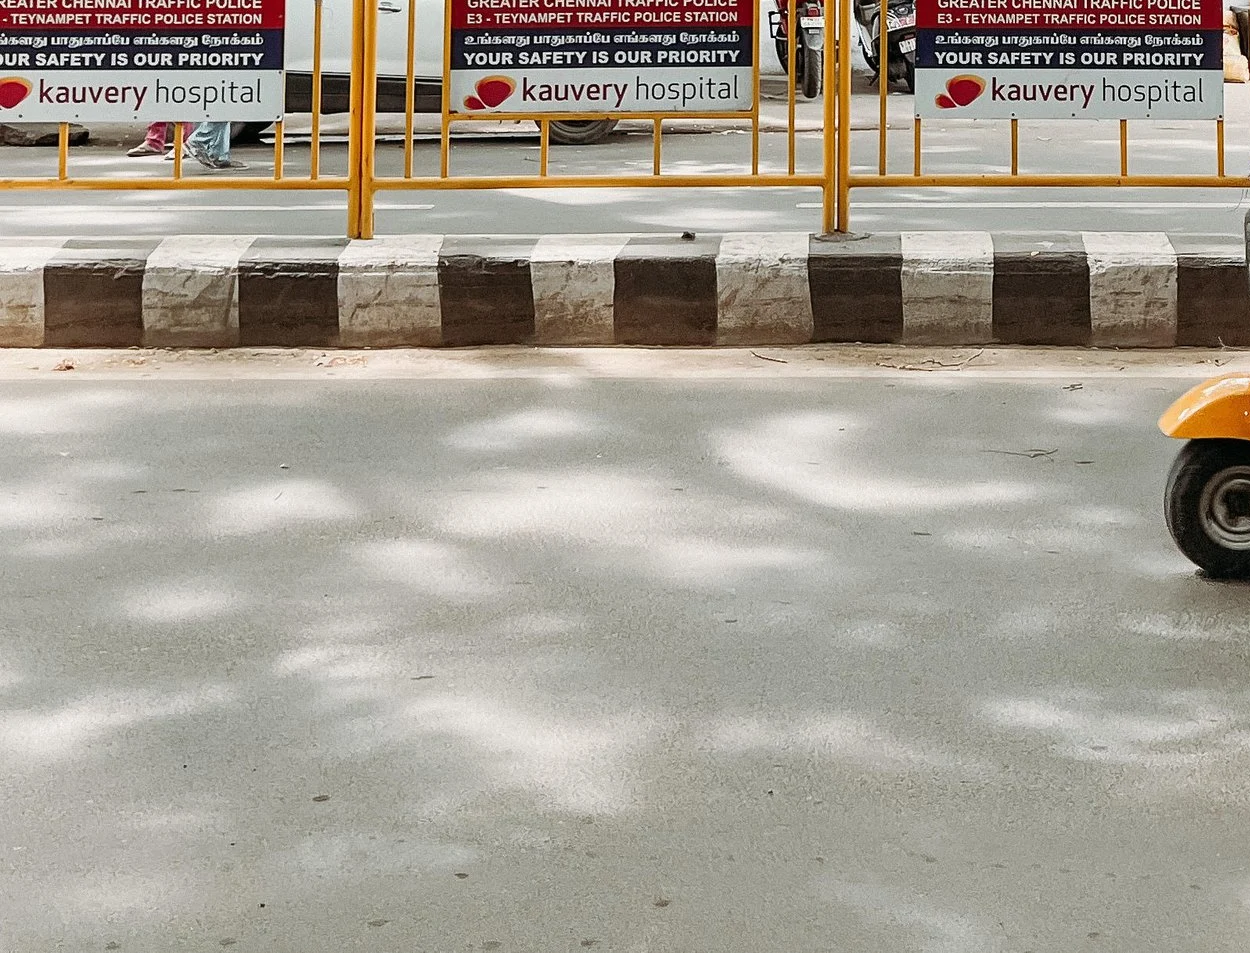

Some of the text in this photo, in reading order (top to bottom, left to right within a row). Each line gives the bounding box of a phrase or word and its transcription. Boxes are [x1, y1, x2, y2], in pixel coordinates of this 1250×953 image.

[10, 13, 91, 25] TEYNAMPET
[95, 13, 151, 25] TRAFFIC
[155, 13, 204, 25] POLICE
[206, 13, 262, 25] STATION
[467, 13, 483, 24] E3
[494, 12, 573, 24] TEYNAMPET
[577, 12, 631, 23] TRAFFIC
[634, 12, 681, 23] POLICE
[684, 11, 738, 23] STATION
[937, 14, 953, 25] E3
[964, 14, 1039, 25] TEYNAMPET
[1043, 14, 1096, 25] TRAFFIC
[1100, 14, 1145, 25] POLICE
[1149, 14, 1201, 25] STATION
[35, 53, 105, 66] SAFETY
[110, 53, 128, 66] IS
[134, 53, 173, 66] OUR
[178, 53, 264, 66] PRIORITY
[464, 50, 740, 65] YOUR SAFETY IS OUR PRIORITY
[935, 52, 1204, 66] YOUR SAFETY IS OUR PRIORITY
[39, 78, 261, 111] kauvery hospital
[523, 75, 739, 108] kauvery hospital
[992, 77, 1203, 109] kauvery hospital
